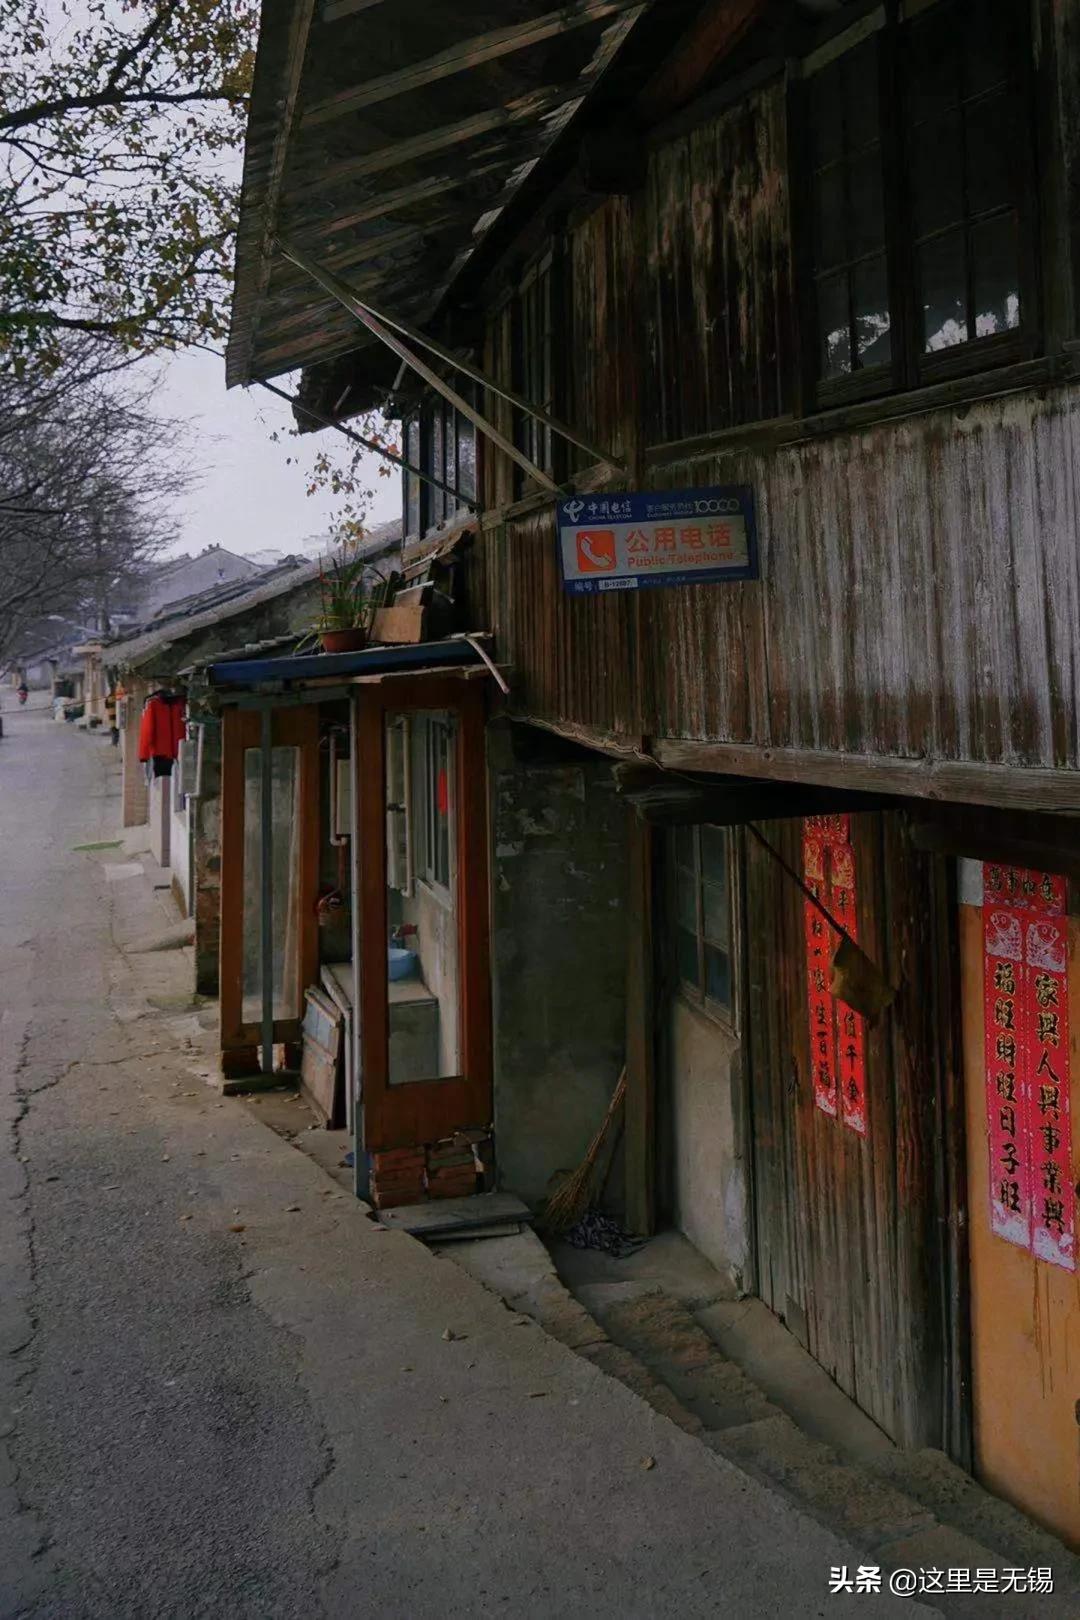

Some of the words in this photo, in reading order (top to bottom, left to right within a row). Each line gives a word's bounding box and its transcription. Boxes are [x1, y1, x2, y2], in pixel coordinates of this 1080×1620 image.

[588, 500, 633, 516] 中国电信
[693, 498, 740, 513] 10000
[625, 523, 731, 553] 公用电话
[627, 556, 665, 568] Public
[667, 551, 737, 565] Telephone
[993, 961, 1022, 1214] 福旺財旺日子旺
